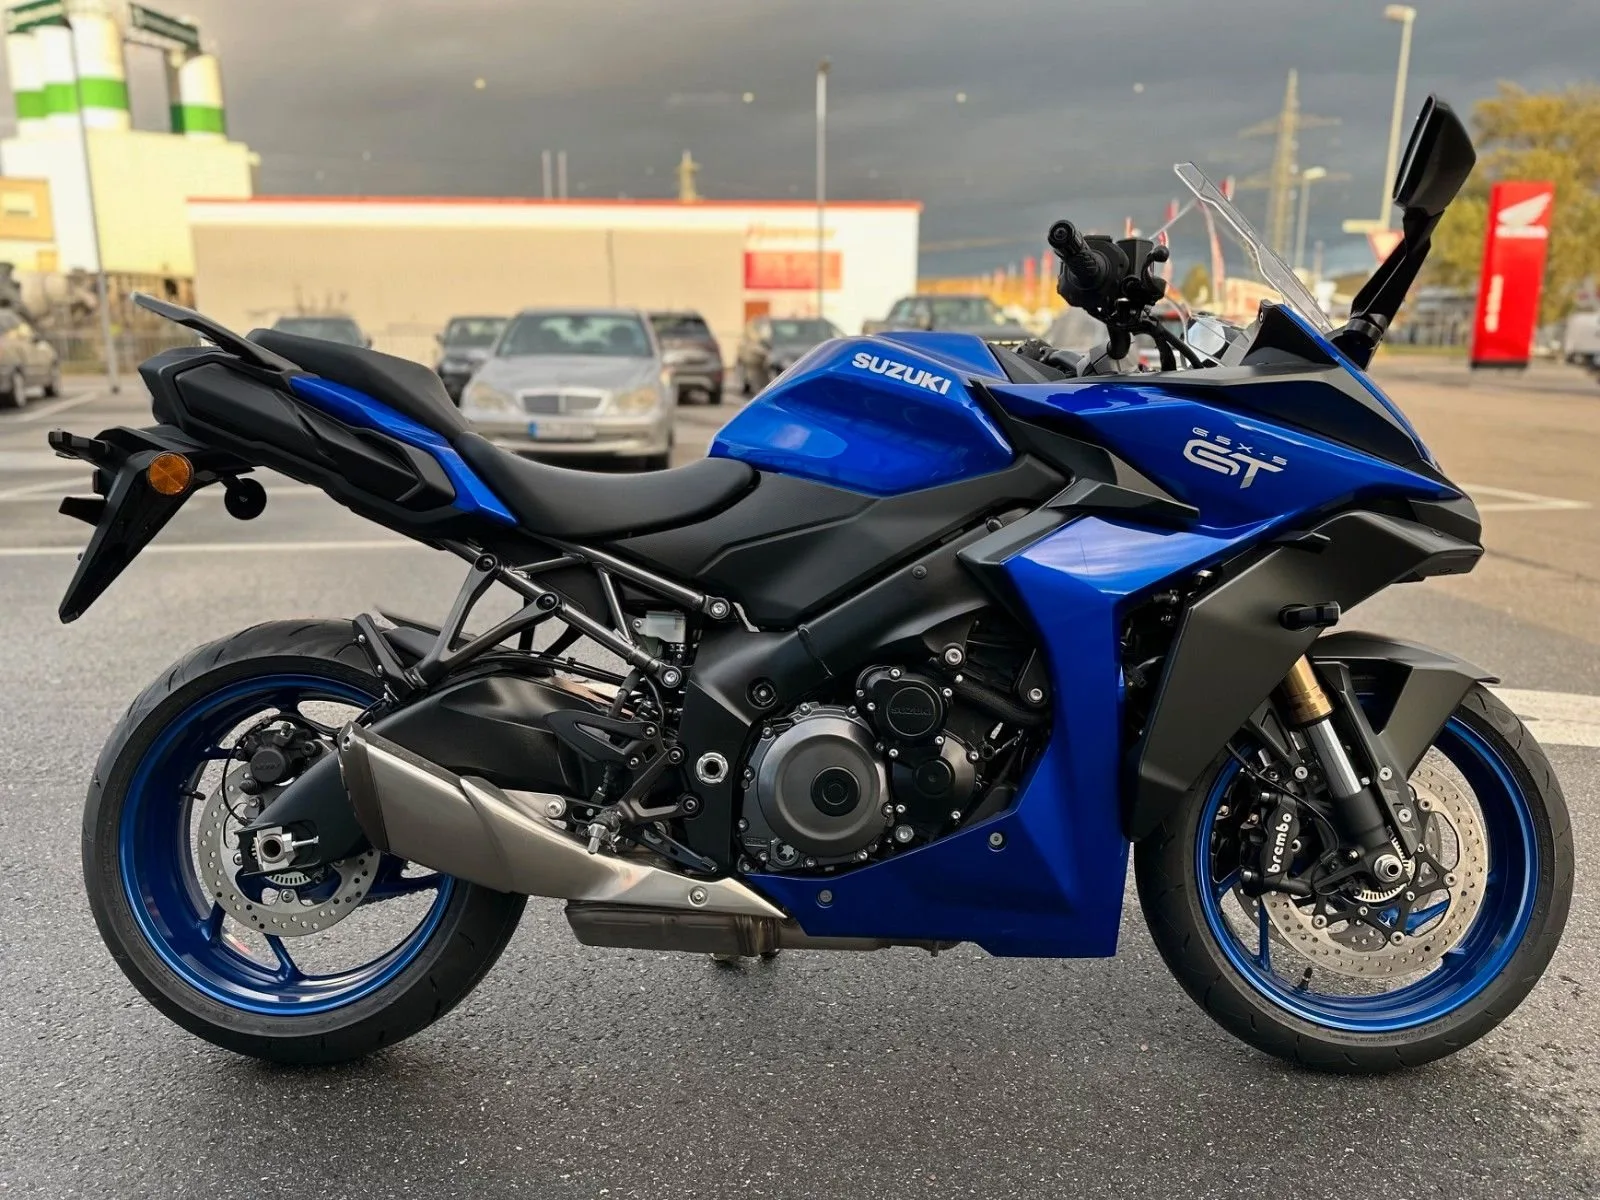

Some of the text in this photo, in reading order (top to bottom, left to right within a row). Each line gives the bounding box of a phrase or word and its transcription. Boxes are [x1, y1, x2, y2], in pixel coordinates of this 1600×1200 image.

[852, 352, 952, 395] SUZUKI
[1192, 427, 1288, 466] GSX-S
[1267, 813, 1292, 873] brembo
